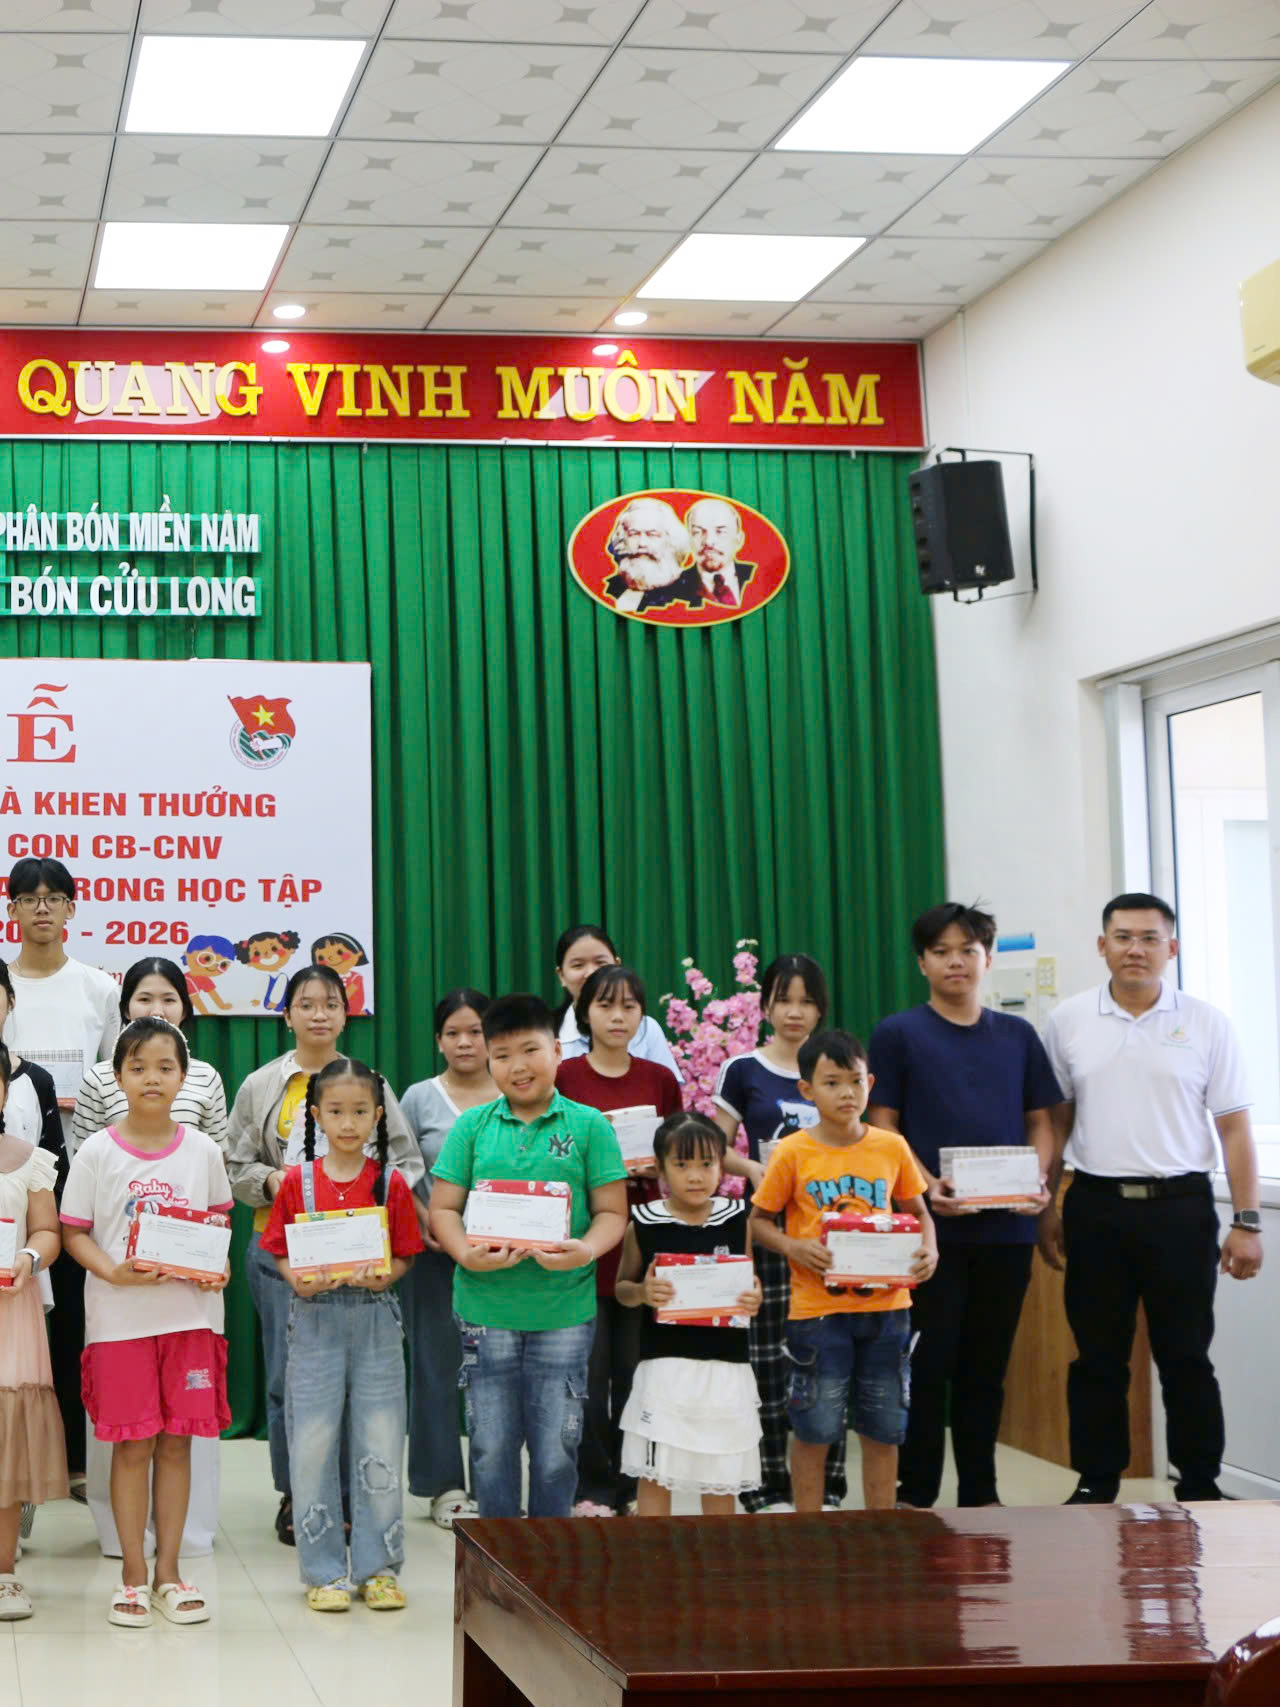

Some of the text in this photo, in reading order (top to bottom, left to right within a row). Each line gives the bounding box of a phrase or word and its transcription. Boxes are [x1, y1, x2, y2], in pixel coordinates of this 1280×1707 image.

[17, 358, 265, 418] QUANG
[286, 362, 471, 418] VINH
[495, 349, 700, 424] MUÔN
[727, 356, 886, 426] NĂM
[66, 501, 120, 552] BÓN
[129, 493, 191, 552] MIỀN
[201, 510, 260, 553] NAM
[11, 566, 80, 616] BÓN
[89, 561, 159, 616] CỬU
[170, 576, 257, 617] LONG
[34, 791, 127, 816] KHEN
[139, 785, 277, 818] THƯỞNG
[8, 833, 79, 859] CON
[92, 834, 223, 860] CB-CNV
[72, 877, 165, 902] RONG
[177, 878, 247, 908] HỌC
[258, 874, 323, 908] TẬP
[105, 920, 190, 945] 2026
[129, 1178, 174, 1201] Baby
